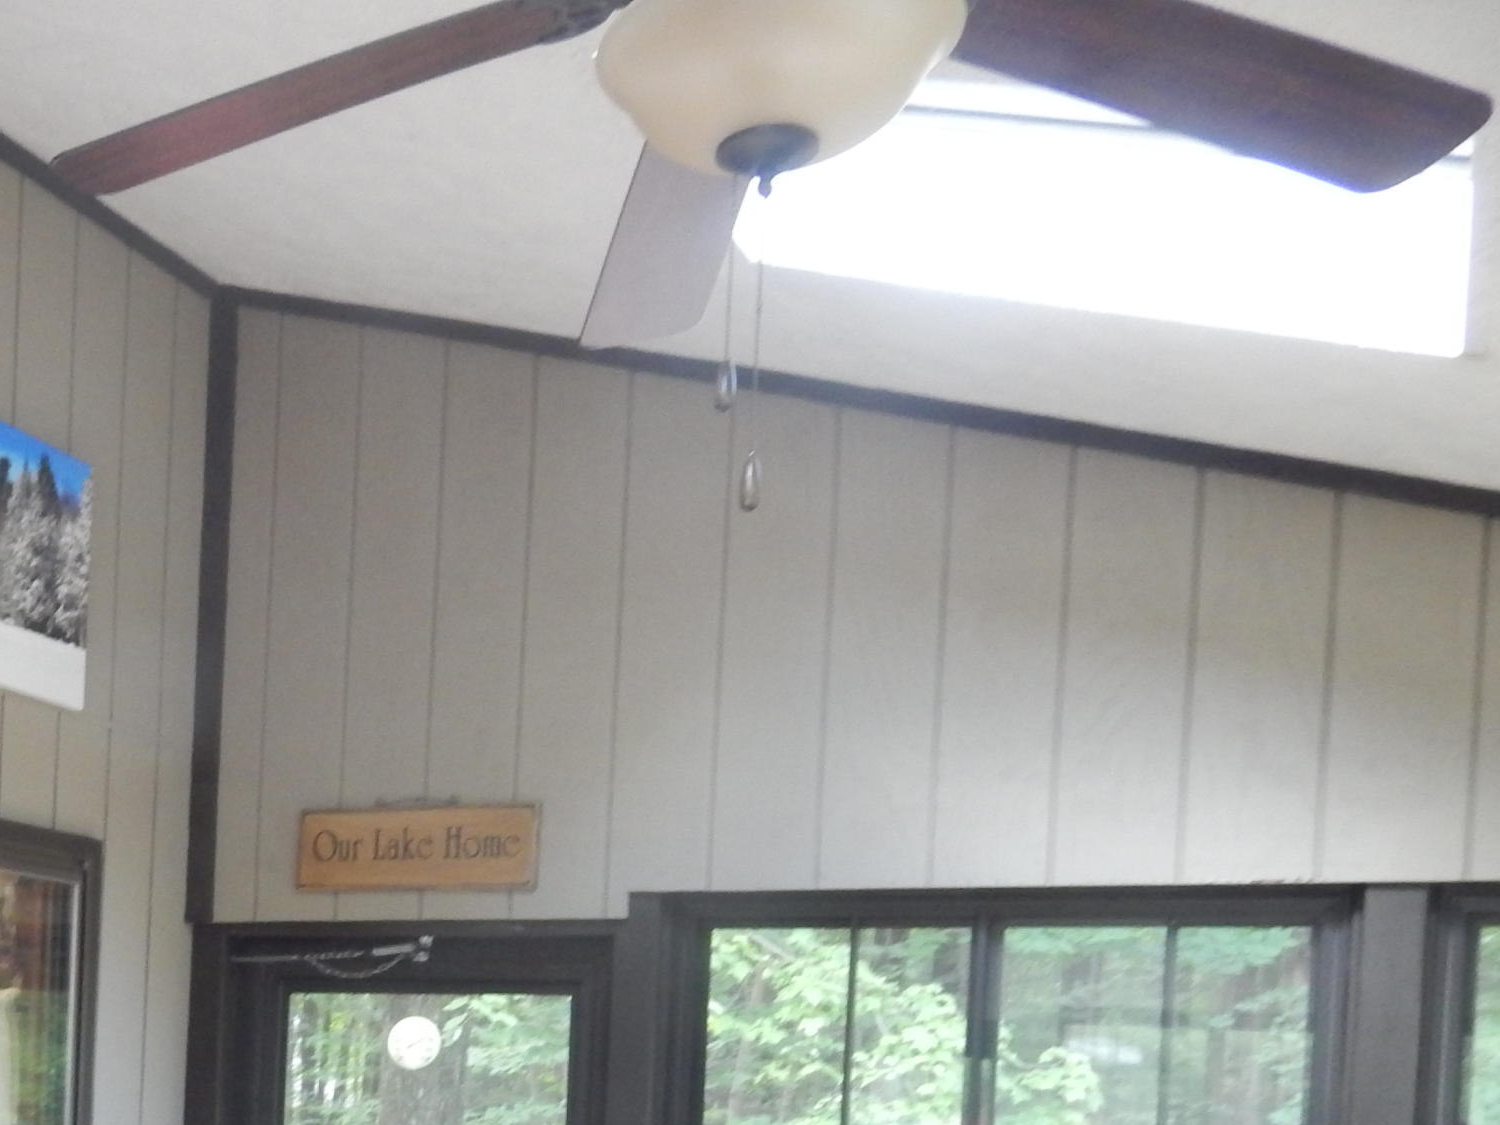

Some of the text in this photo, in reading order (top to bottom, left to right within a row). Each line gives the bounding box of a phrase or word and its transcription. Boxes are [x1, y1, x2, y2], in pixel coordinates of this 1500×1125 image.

[312, 825, 521, 863] Our Lake Home
